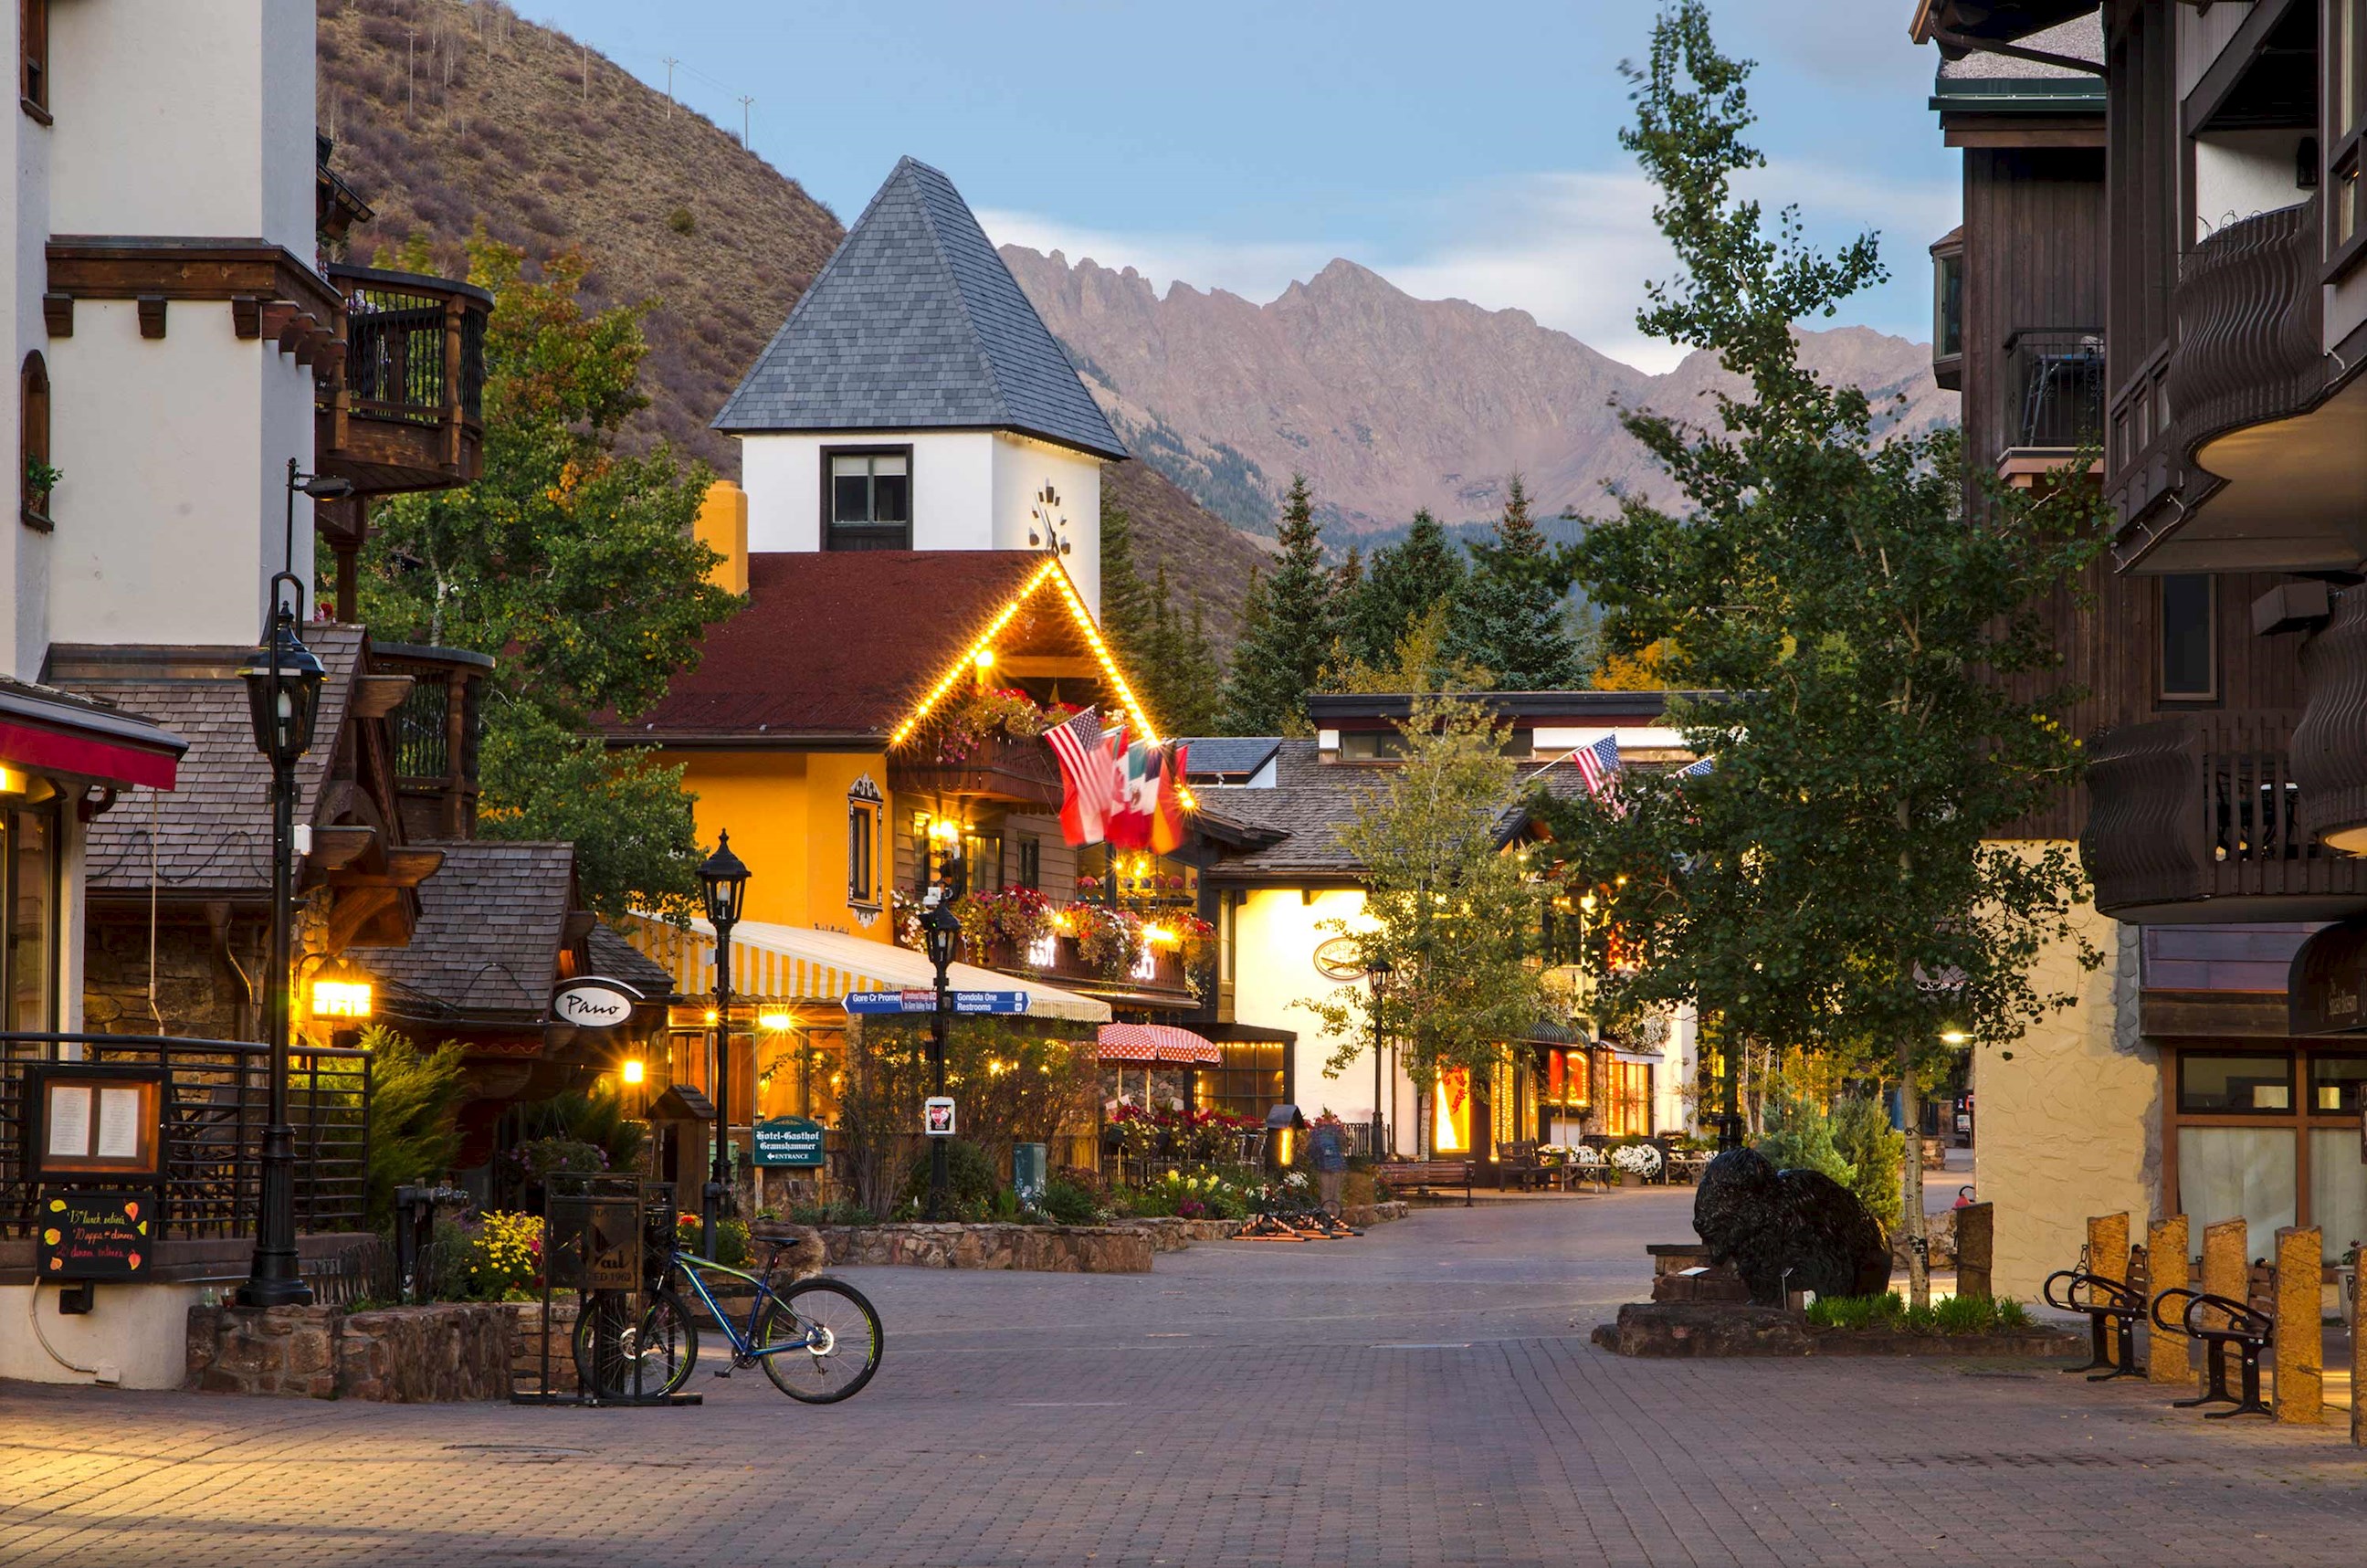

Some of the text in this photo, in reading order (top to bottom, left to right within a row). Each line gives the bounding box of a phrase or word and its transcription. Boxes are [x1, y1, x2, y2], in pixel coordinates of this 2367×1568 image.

[853, 994, 868, 1002] Gore
[869, 994, 877, 1002] Cr
[957, 993, 997, 1002] Gondola One
[957, 1003, 992, 1011] Restrooms
[756, 1131, 820, 1142] Hotel-Gasthof
